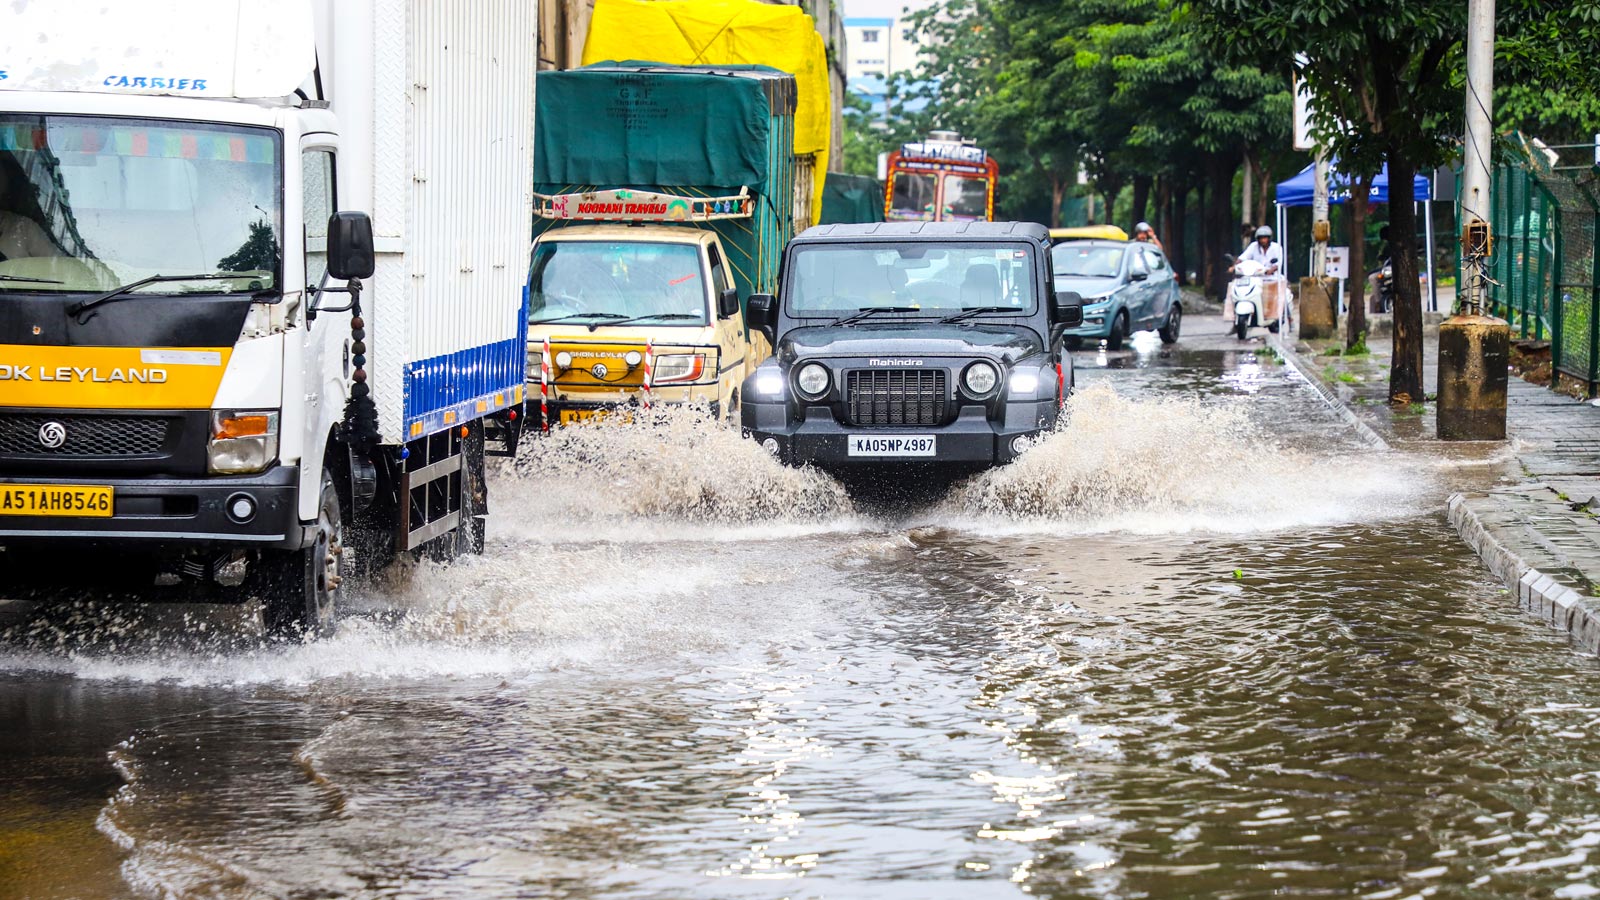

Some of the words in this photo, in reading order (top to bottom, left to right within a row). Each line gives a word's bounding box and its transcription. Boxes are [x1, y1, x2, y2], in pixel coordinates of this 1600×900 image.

[103, 75, 208, 90] CARRIER
[624, 203, 667, 215] TRAVELS
[40, 366, 168, 383] LEYLAND
[857, 439, 934, 452] KA05NP4987
[2, 490, 109, 511] A51AH8546
